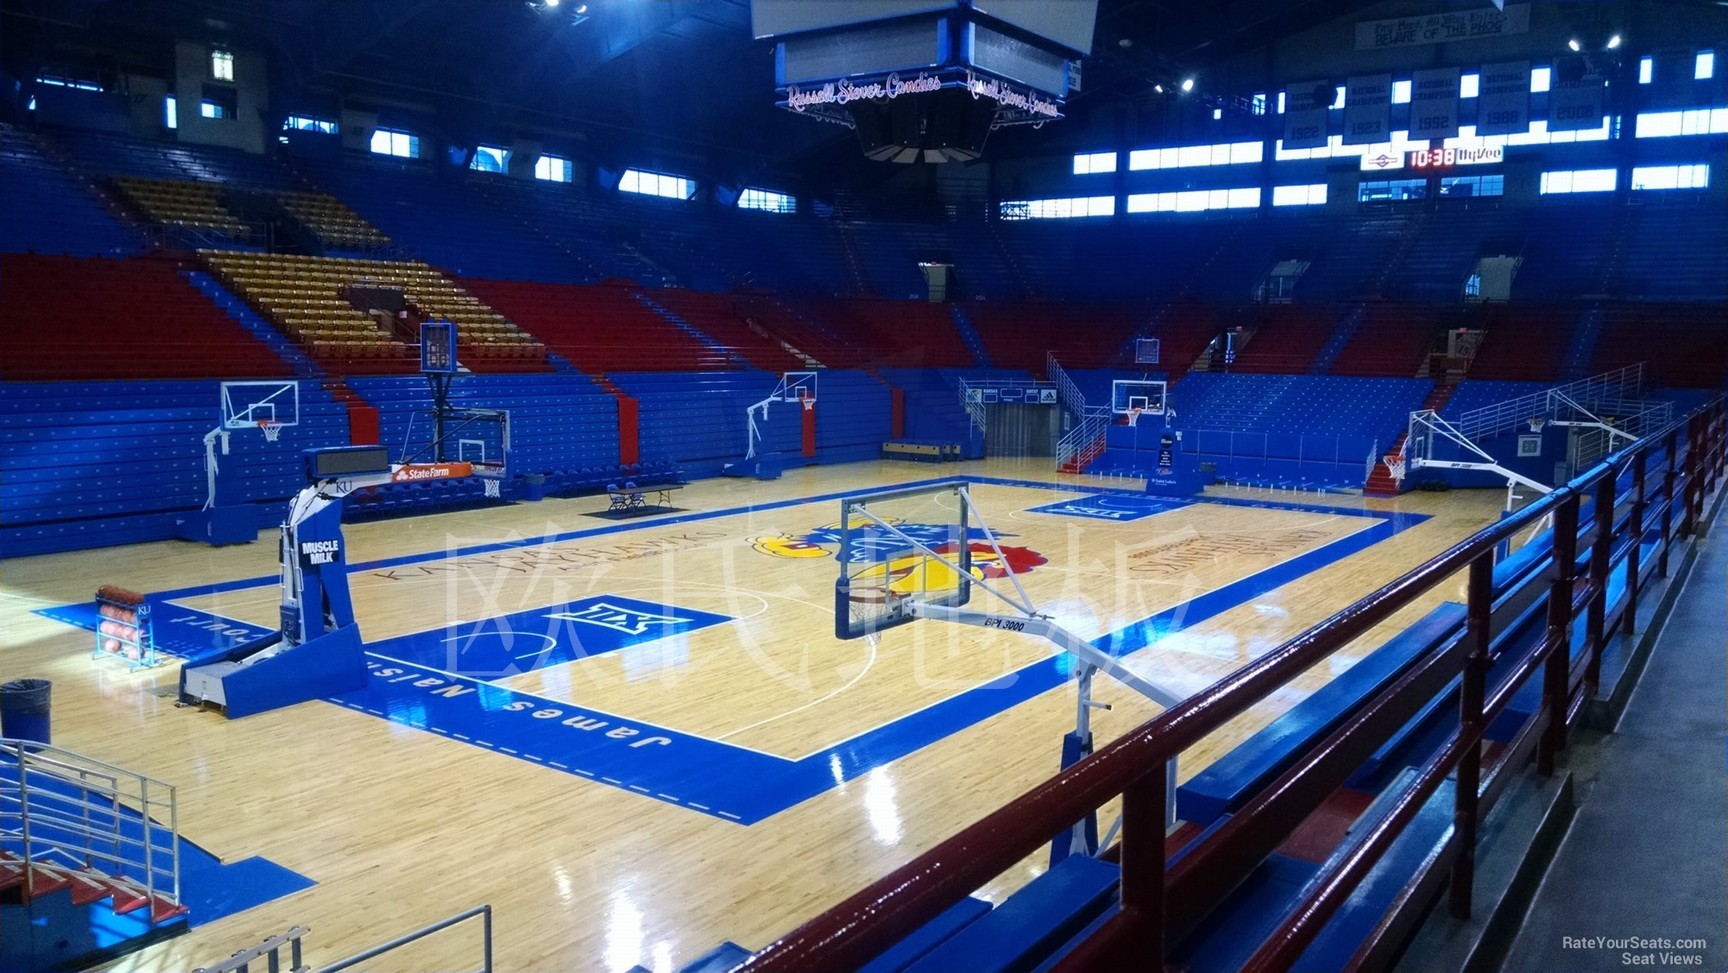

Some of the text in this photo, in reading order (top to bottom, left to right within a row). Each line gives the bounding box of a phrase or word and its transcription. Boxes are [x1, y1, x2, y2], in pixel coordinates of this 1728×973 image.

[1375, 21, 1503, 47] BEWARE OF THE PHOG
[787, 72, 942, 112] Russell Stover Candies
[967, 69, 1000, 100] Russell
[1028, 89, 1059, 117] Candies
[1291, 126, 1320, 140] 1922
[1352, 121, 1381, 135] 1923
[1411, 149, 1455, 167] 10:38
[336, 481, 353, 494] KU
[302, 540, 339, 554] MUSCLE
[310, 552, 333, 565] MILK
[137, 606, 151, 616] KU
[984, 617, 1025, 632] BPI 3000
[503, 700, 673, 748] James
